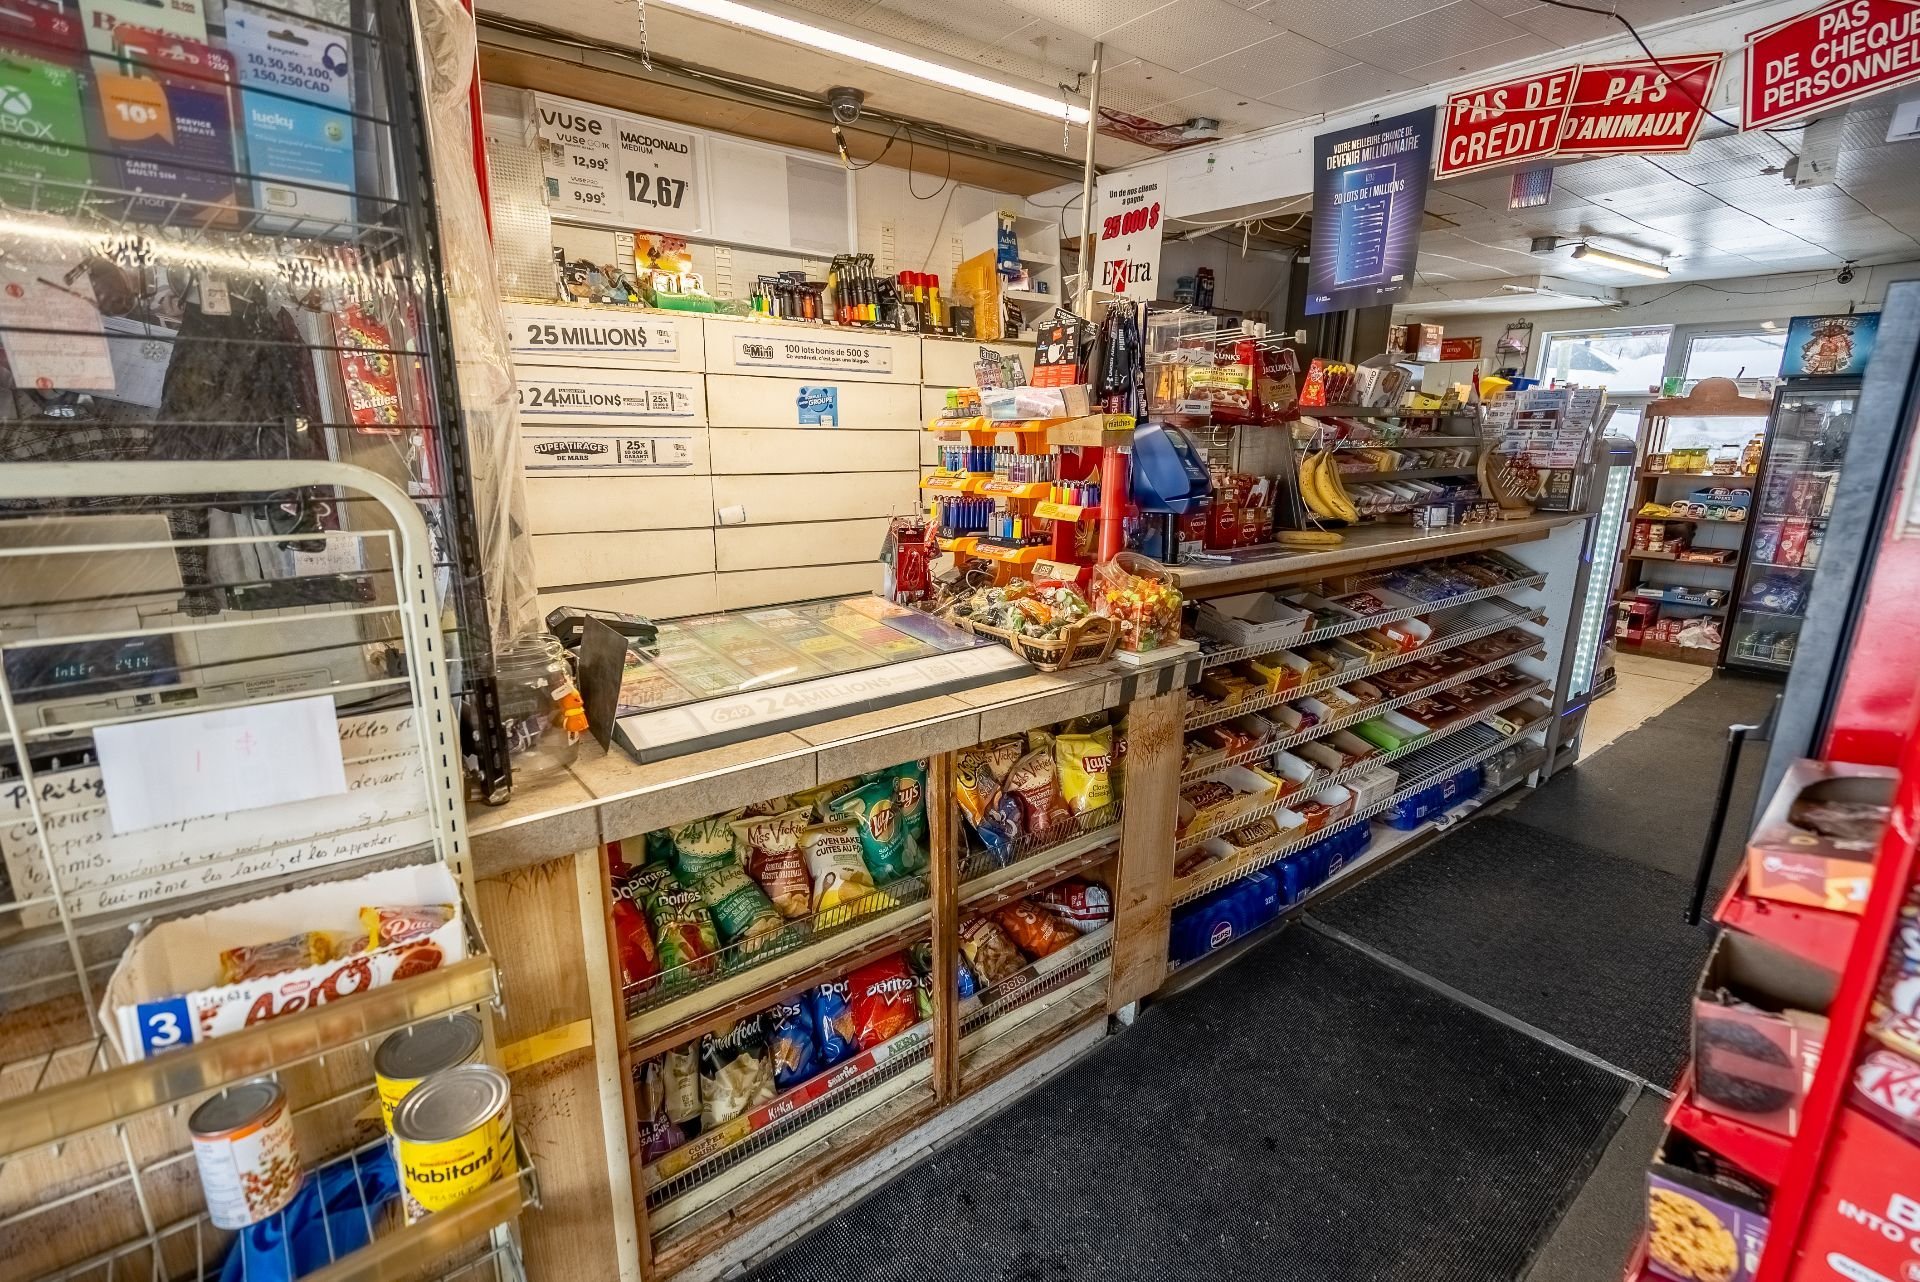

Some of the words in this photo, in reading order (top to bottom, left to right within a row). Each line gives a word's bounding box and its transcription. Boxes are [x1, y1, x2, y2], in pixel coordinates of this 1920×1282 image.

[1819, 0, 1870, 40] PAS
[1766, 52, 1799, 85] DE
[1454, 90, 1507, 125] PAS
[1525, 75, 1566, 109] DE
[1604, 74, 1668, 106] PAS
[176, 116, 212, 130] SERVICE
[252, 109, 294, 130] lucky
[1561, 112, 1691, 140] D'ANIMAUX
[620, 130, 688, 154] MACDONALD
[621, 143, 653, 155] MEDIUM
[1333, 140, 1351, 155] VOTRE
[1351, 134, 1381, 151] MEILLEURE
[1381, 127, 1404, 143] CHANCE
[1405, 125, 1414, 137] DE
[1450, 115, 1556, 166] CRÉDIT
[1326, 150, 1360, 171] DEVENIR
[1361, 133, 1421, 163] MILLIONNAIRE
[1109, 190, 1118, 198] Un
[1118, 188, 1126, 197] de
[1126, 187, 1137, 197] nos
[1138, 183, 1158, 194] clients
[1333, 193, 1343, 206] 20
[1343, 189, 1358, 204] LOTS
[1359, 187, 1369, 200] DE
[1101, 214, 1122, 240] 25
[1121, 206, 1149, 236] 000
[1148, 202, 1161, 229] $
[1000, 236, 1017, 246] Advil
[527, 324, 559, 345] 25
[561, 326, 647, 348] MILLION$
[785, 344, 800, 354] 100
[801, 345, 815, 355] lots
[815, 346, 835, 355] bonis
[836, 347, 846, 356] de
[846, 348, 862, 358] 500
[864, 349, 870, 358] $
[353, 394, 398, 411] Skittles
[528, 386, 560, 408] 24
[559, 393, 622, 407] MILLION$
[808, 395, 834, 407] GROUPE
[1109, 419, 1131, 428] matches
[534, 442, 567, 454] SUPER
[567, 442, 609, 454] TIRAGES
[1552, 472, 1571, 482] 20
[1085, 753, 1112, 775] Lay's
[816, 837, 842, 848] OVEN
[816, 844, 843, 857] CUITES
[842, 843, 854, 853] AU
[628, 867, 672, 891] Doritos
[658, 890, 702, 907] Doritos
[1211, 928, 1232, 945] PEPSI
[999, 975, 1027, 996] Rolo
[149, 1011, 182, 1047] 3
[702, 1013, 762, 1062] Smartfood
[887, 1032, 921, 1058] AERO
[768, 1100, 794, 1121] KitKat
[688, 1132, 725, 1155] COFFEE
[405, 1146, 496, 1184] Habitant
[1836, 1198, 1905, 1243] INTO
